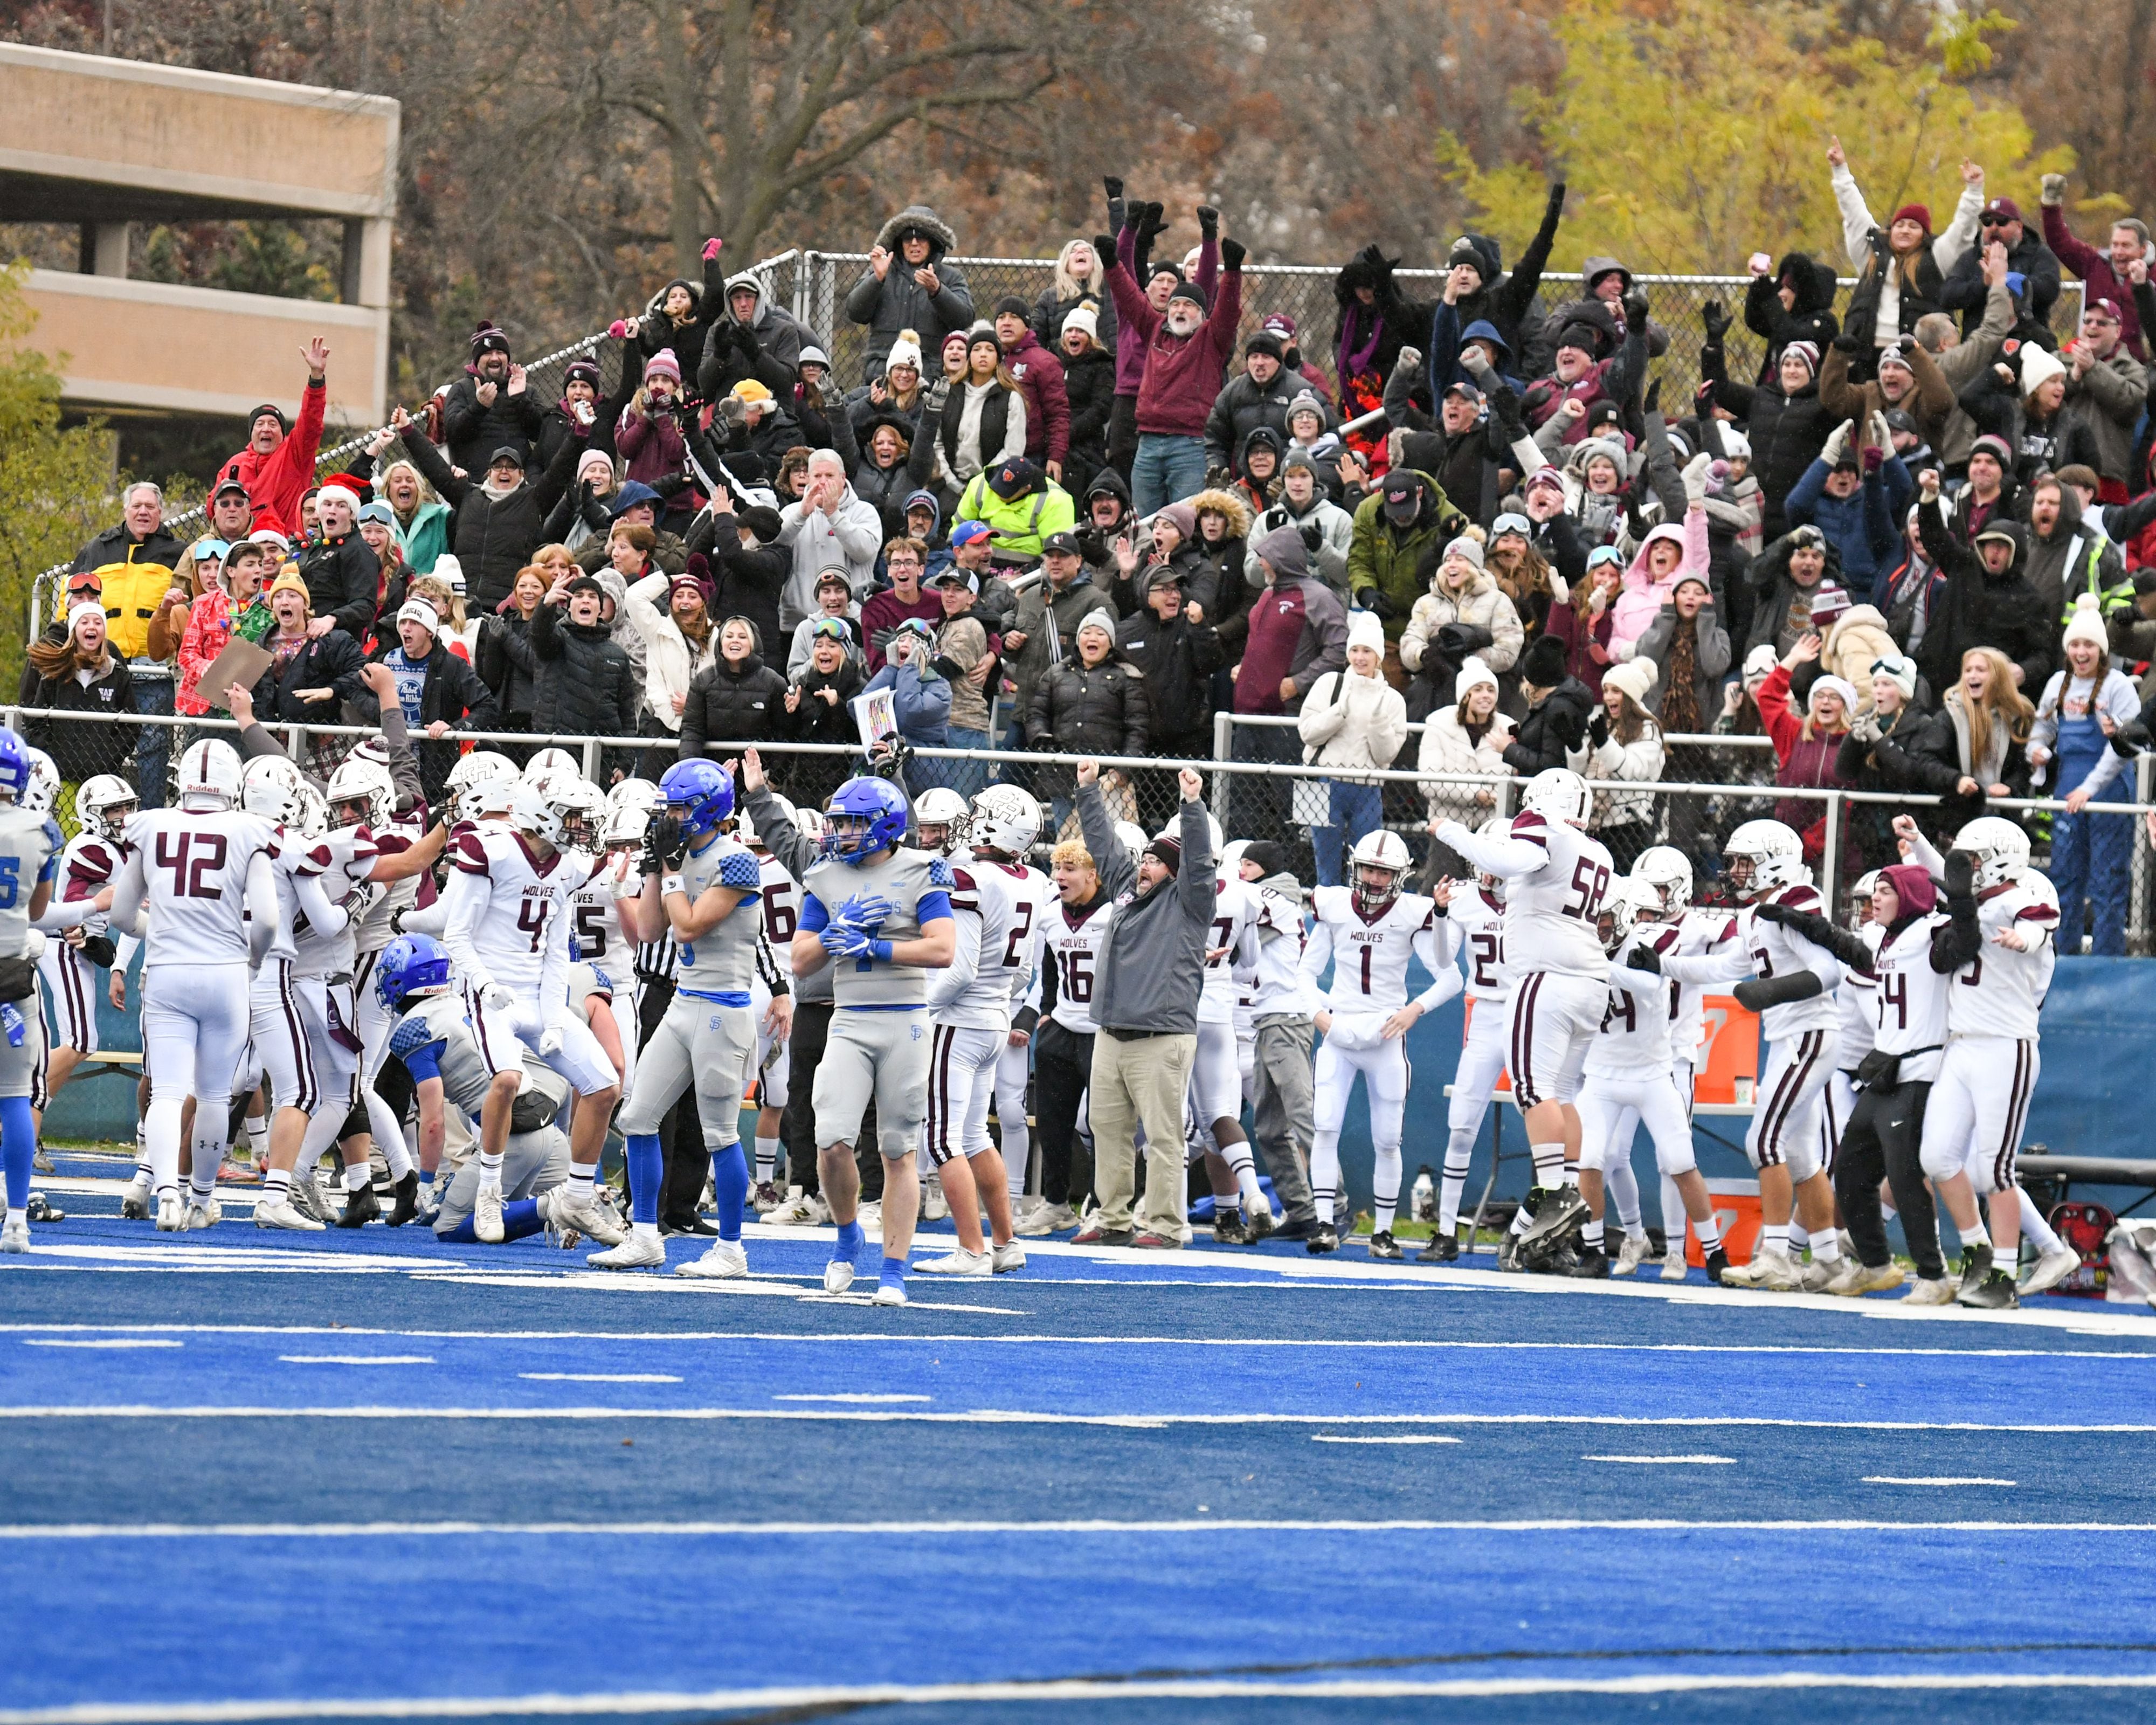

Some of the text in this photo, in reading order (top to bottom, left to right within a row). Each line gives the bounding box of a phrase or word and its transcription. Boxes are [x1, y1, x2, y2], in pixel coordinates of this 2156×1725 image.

[403, 608, 423, 619] CHICAGO
[405, 694, 422, 703] Ribbo
[186, 784, 219, 794] Riddell
[156, 832, 227, 900] 42
[522, 885, 555, 897] WOLVES
[573, 893, 593, 903] LVES
[1561, 855, 1609, 925] 58
[517, 899, 548, 953] 4
[1001, 902, 1033, 967] 2
[1350, 931, 1384, 943] WOLVES
[1483, 922, 1505, 932] WOLV
[1060, 938, 1088, 949] WOLVES
[1205, 917, 1233, 968] 7
[1359, 944, 1372, 995] 1
[1471, 934, 1505, 987] 2
[1058, 951, 1094, 1003] 16
